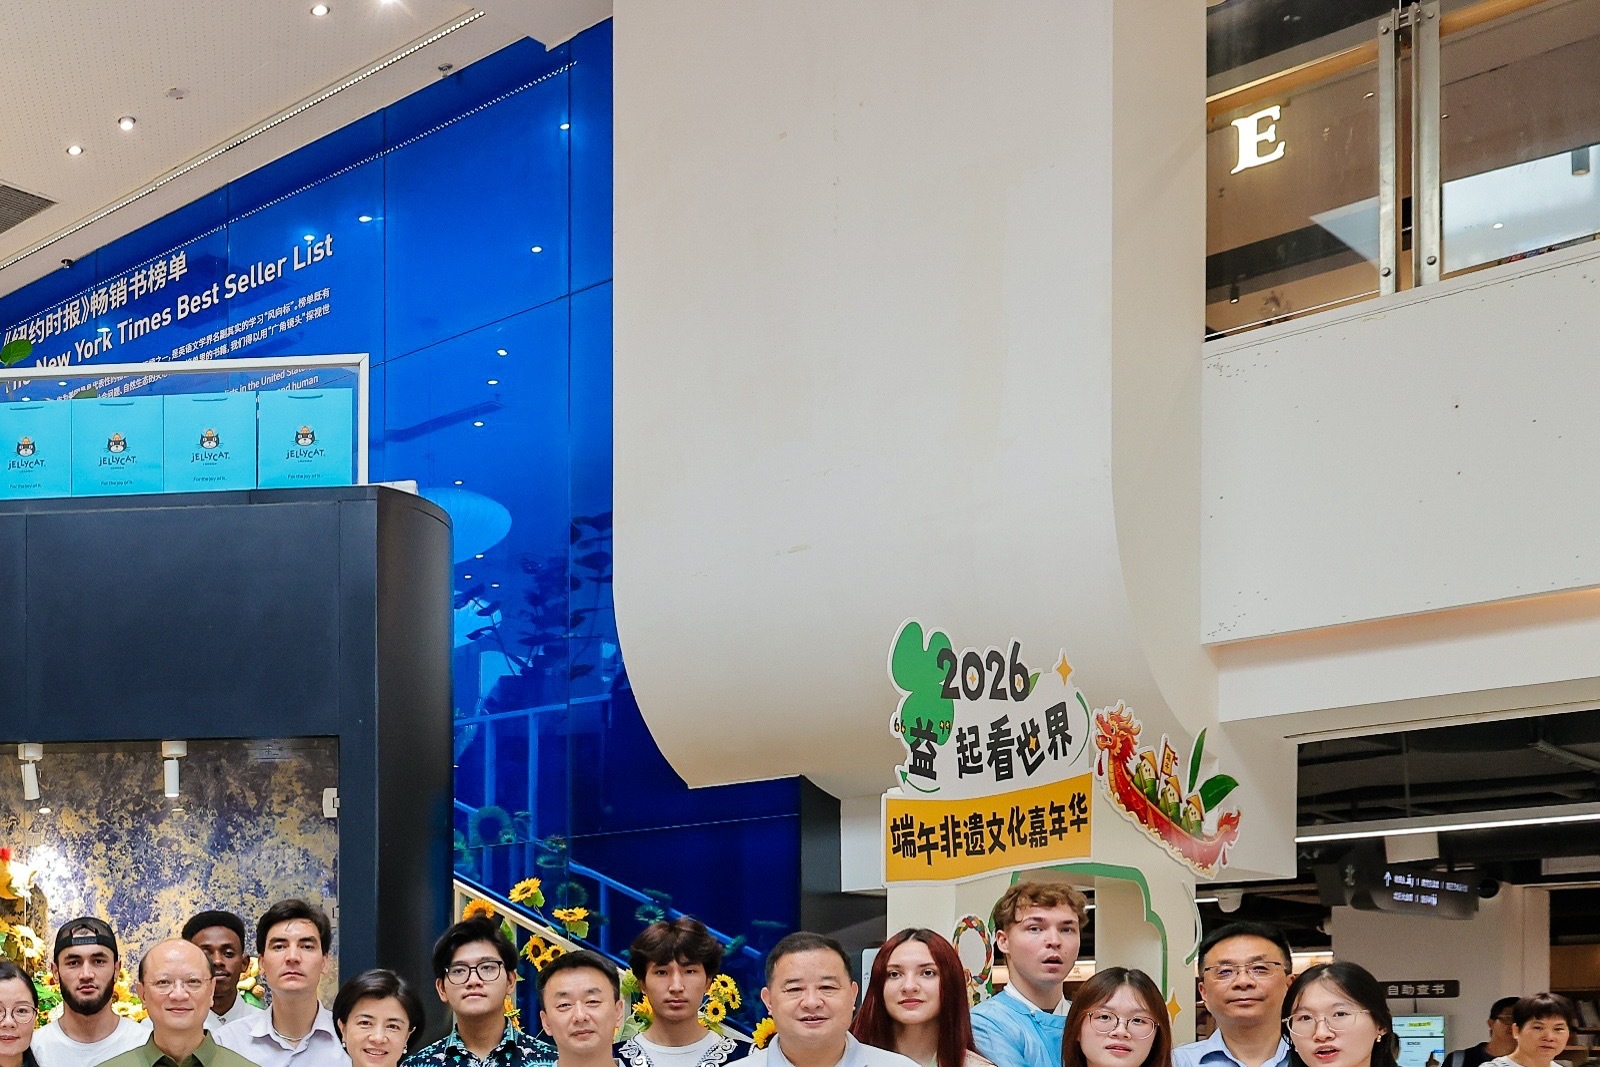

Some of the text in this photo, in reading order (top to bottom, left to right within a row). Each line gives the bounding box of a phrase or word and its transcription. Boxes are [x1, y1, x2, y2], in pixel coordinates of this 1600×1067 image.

[1230, 104, 1286, 175] E
[74, 329, 113, 363] York
[117, 308, 172, 346] Times
[177, 284, 220, 321] Best
[224, 258, 286, 297] Seller
[293, 233, 334, 271] List
[261, 370, 286, 386] United
[292, 375, 319, 391] human
[936, 641, 1030, 702] 2026
[890, 792, 1089, 866] 端午非遗文化嘉年华
